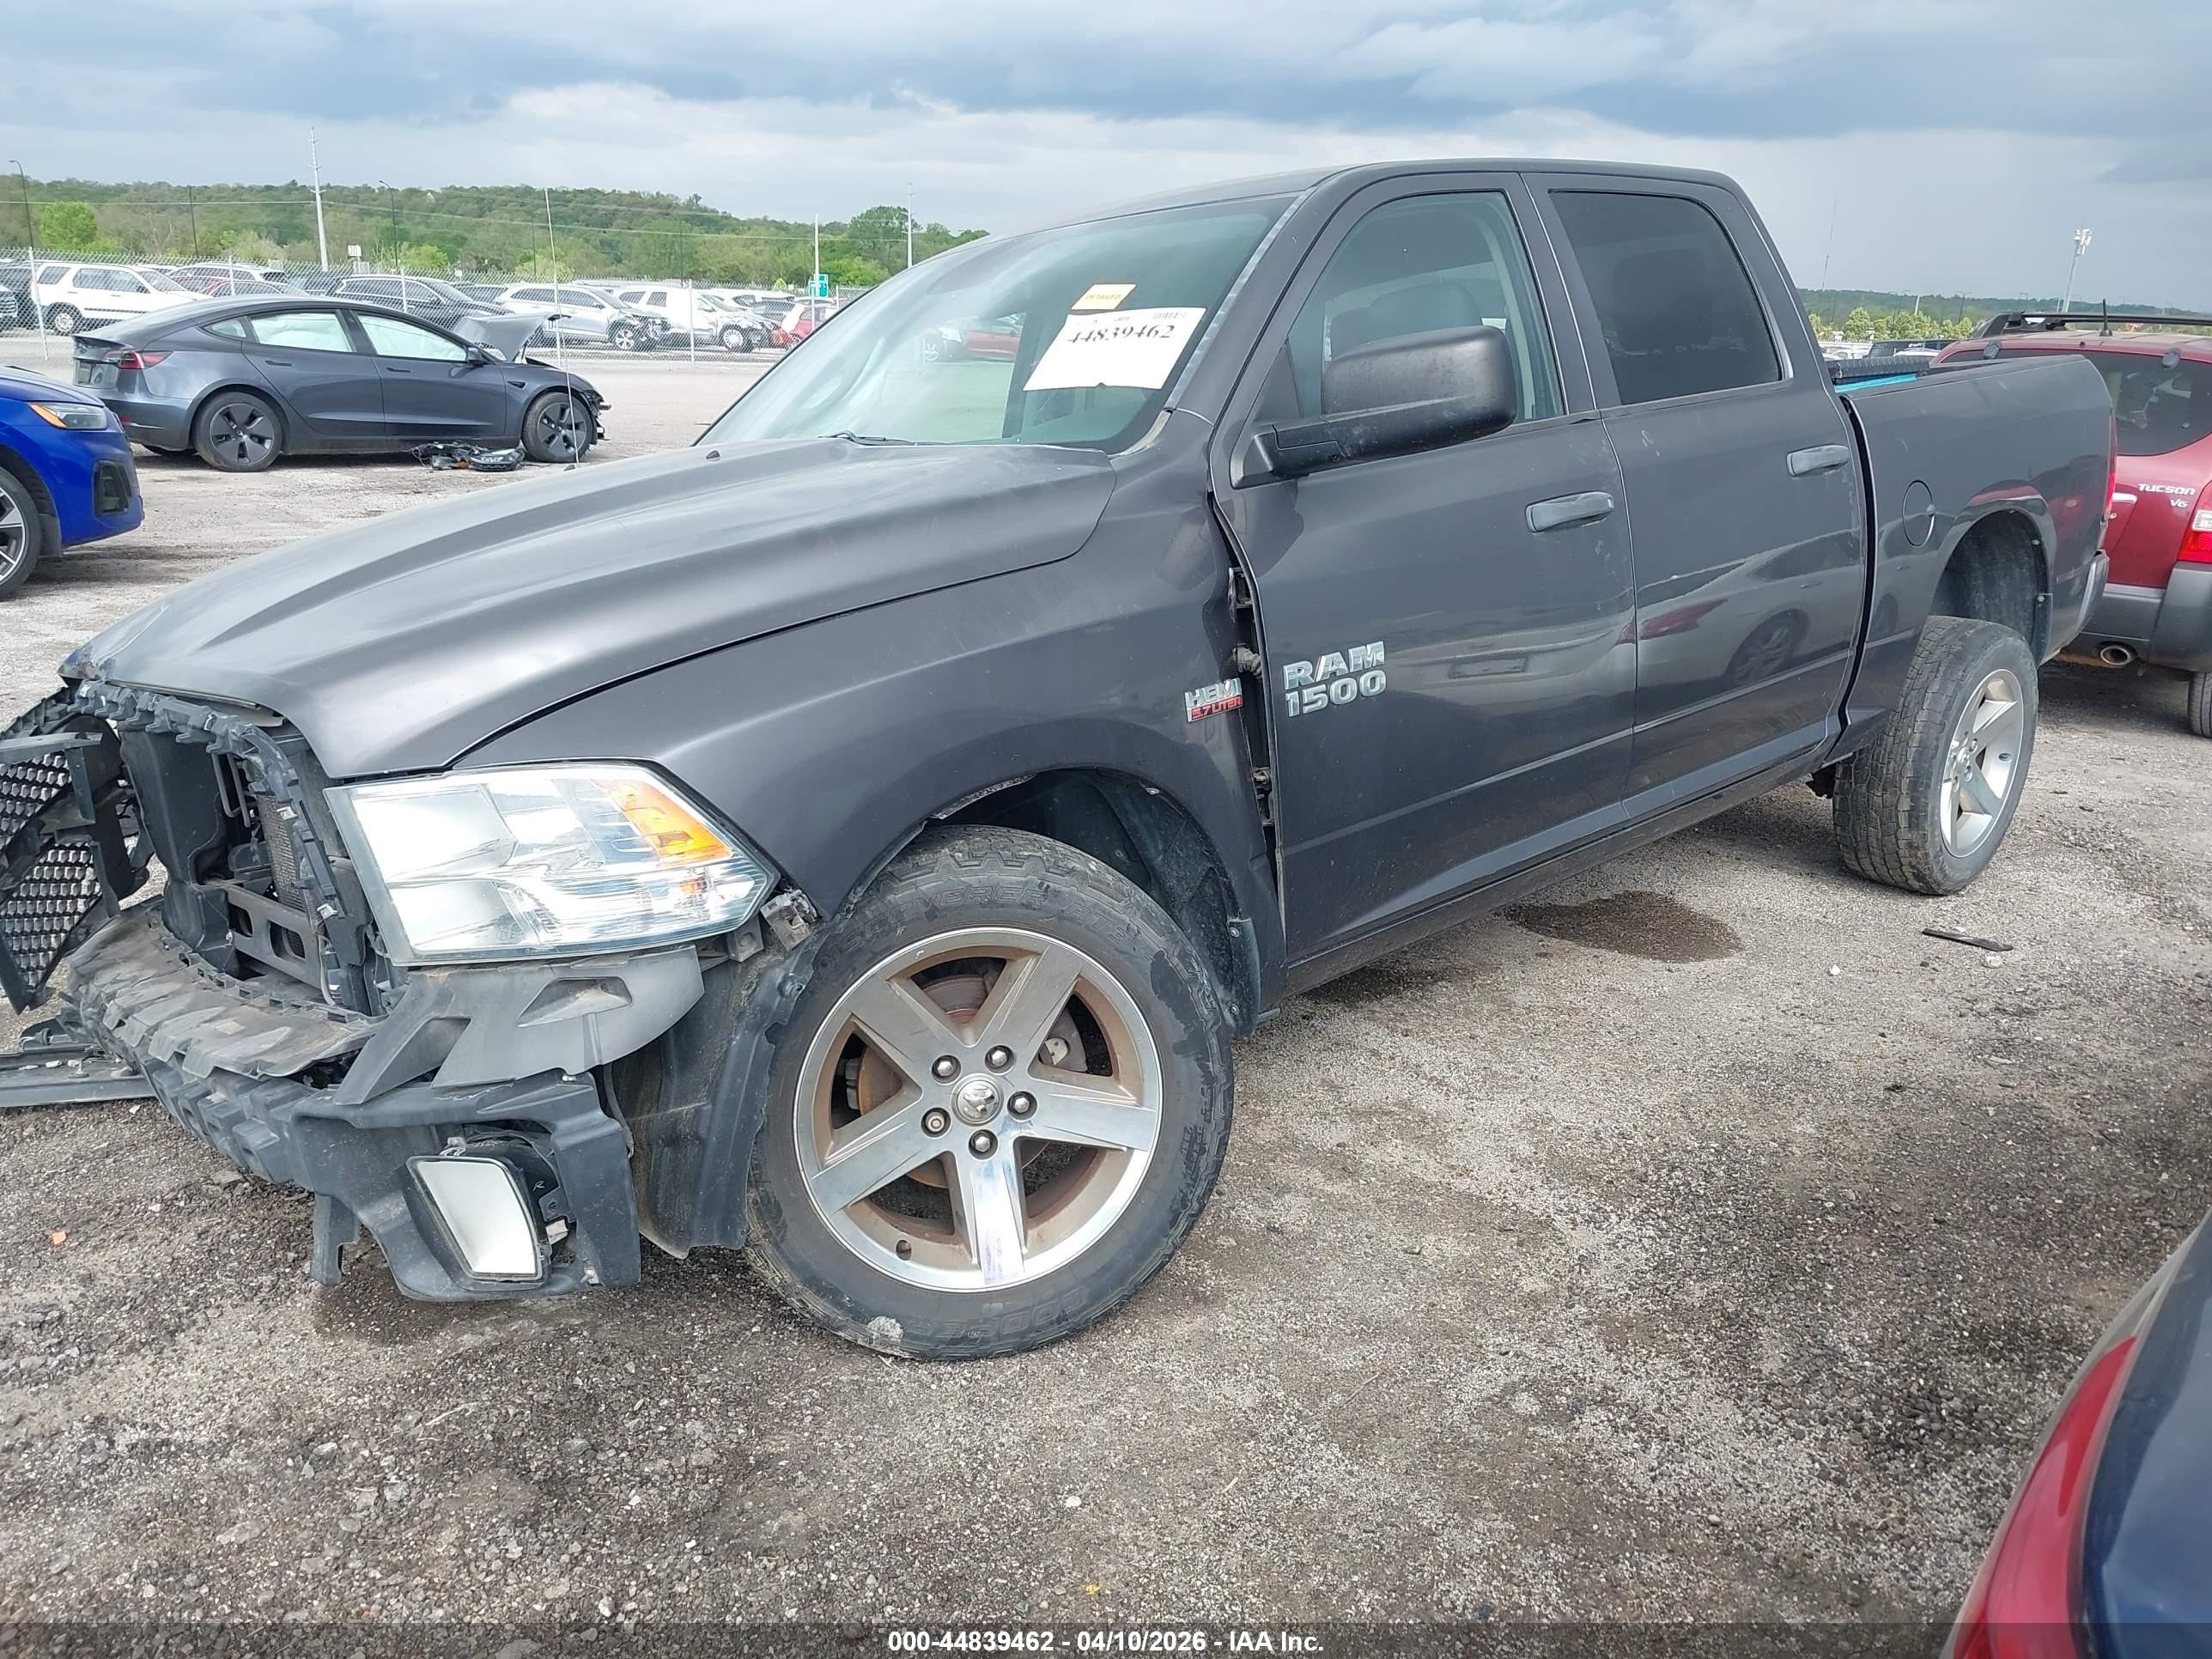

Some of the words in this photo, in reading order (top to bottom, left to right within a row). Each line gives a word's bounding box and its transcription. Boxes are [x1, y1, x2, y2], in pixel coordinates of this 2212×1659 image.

[1067, 324, 1176, 344] 44839462
[2137, 483, 2197, 495] TUCSON
[2170, 498, 2189, 508] V6
[1282, 641, 1385, 690] RAM
[1184, 678, 1243, 709] HEMI
[1285, 669, 1387, 718] 1500
[1212, 696, 1242, 714] LITER
